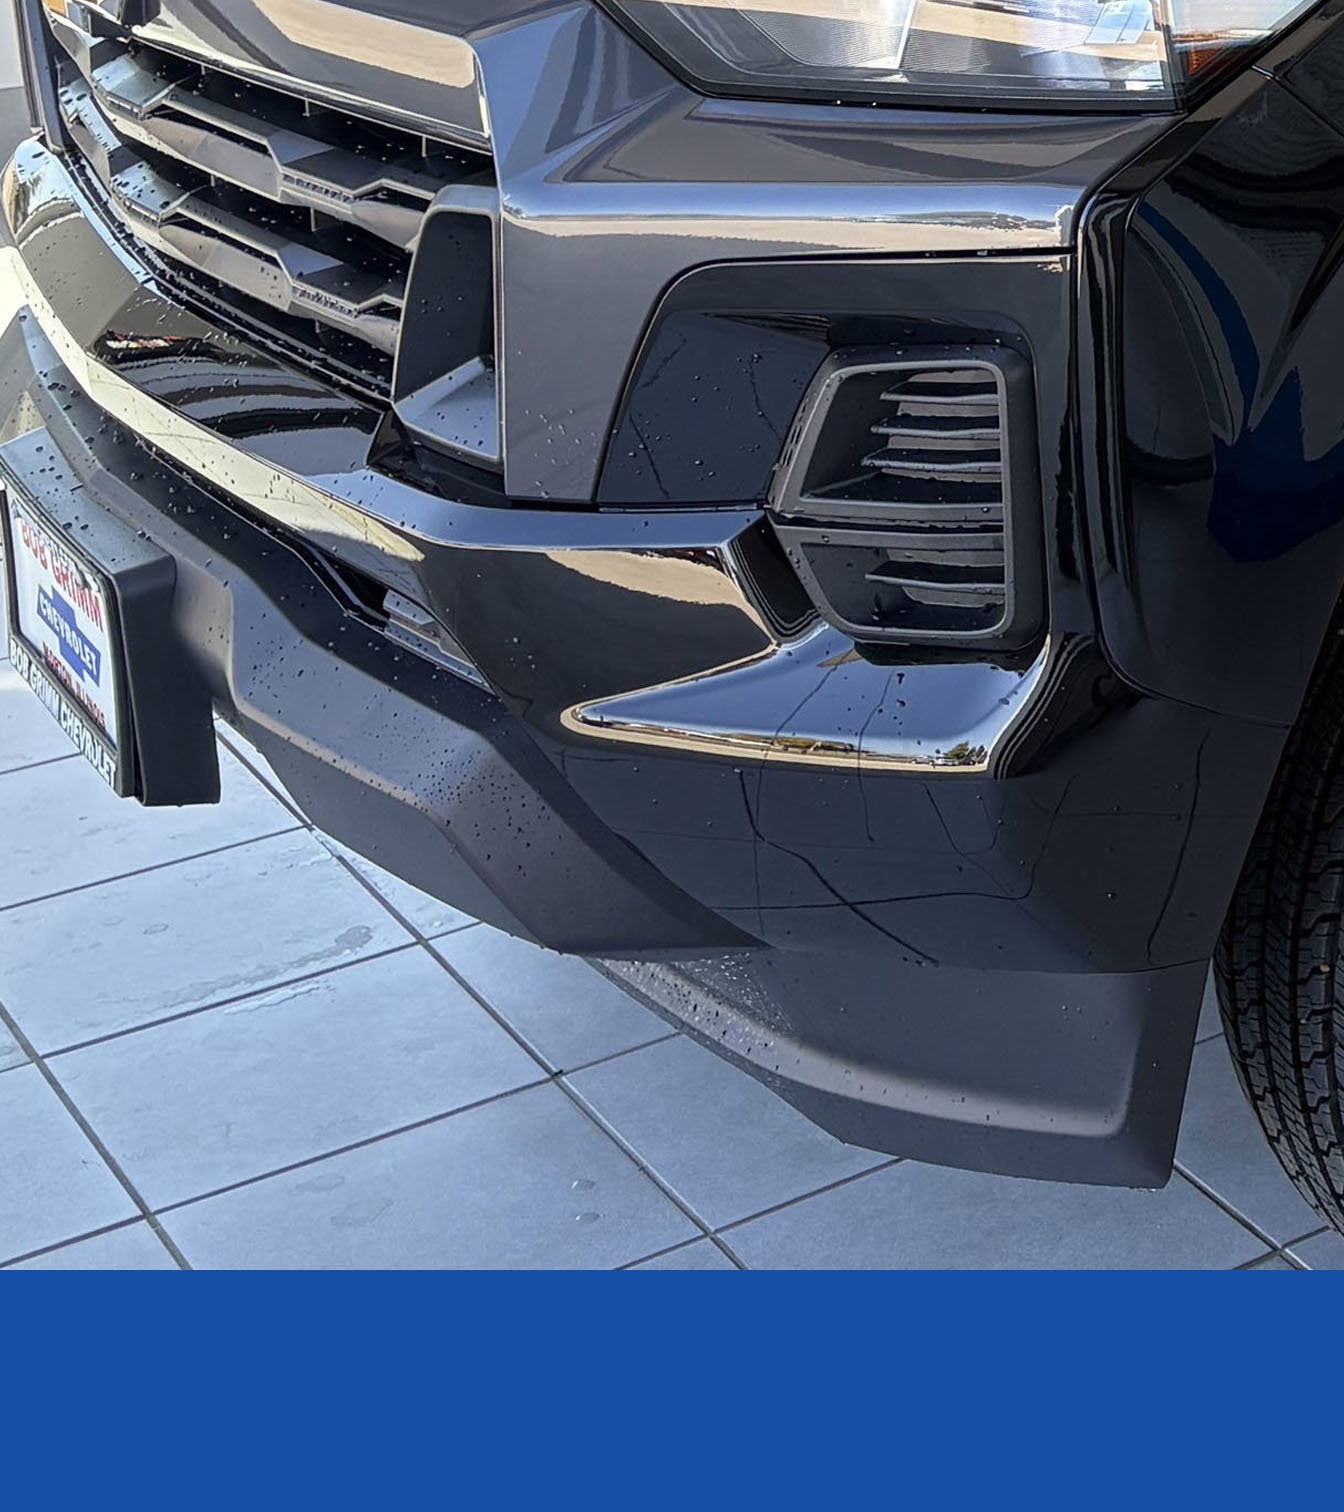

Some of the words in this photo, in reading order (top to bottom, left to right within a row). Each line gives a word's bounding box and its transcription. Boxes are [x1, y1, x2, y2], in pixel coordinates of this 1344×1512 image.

[39, 592, 97, 676] CHEVROLET
[9, 639, 29, 682] BOB
[60, 701, 117, 789] CHEVROLET
